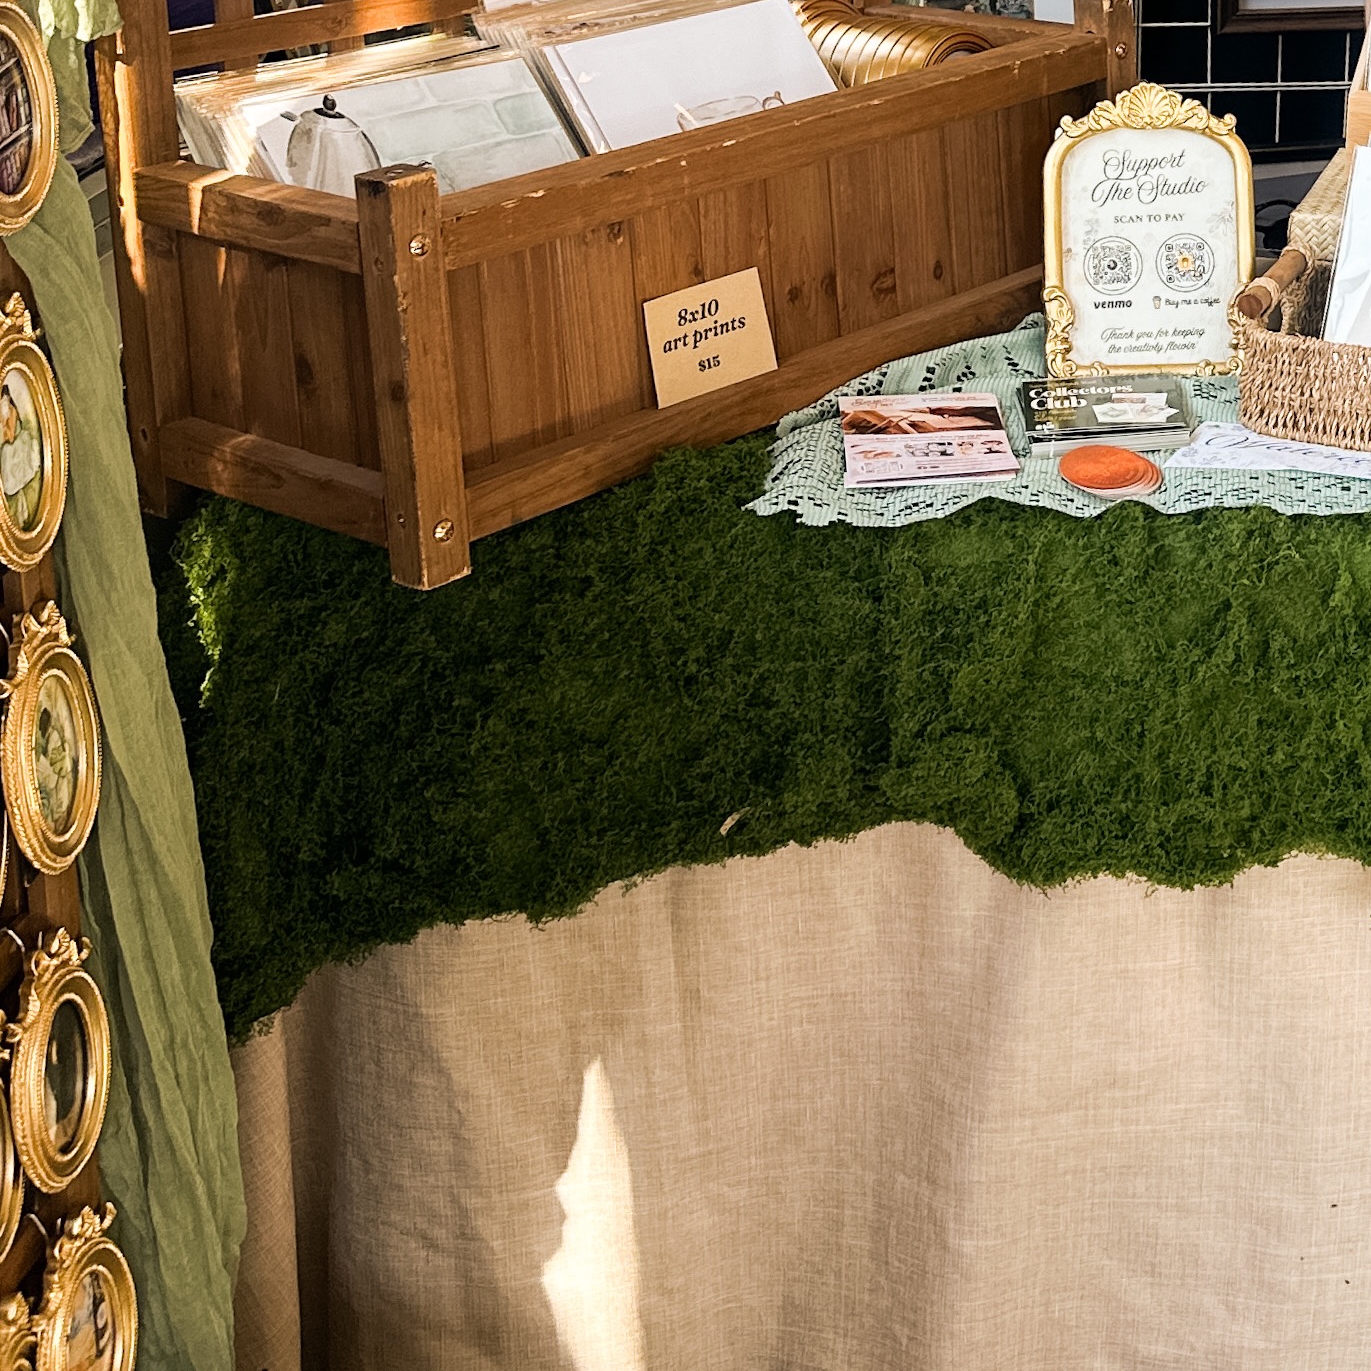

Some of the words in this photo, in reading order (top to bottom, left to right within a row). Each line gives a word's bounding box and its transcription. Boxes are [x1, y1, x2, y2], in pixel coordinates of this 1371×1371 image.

[1103, 149, 1186, 181] Support
[1092, 179, 1134, 207] The
[1137, 174, 1209, 205] Studio
[1114, 215, 1144, 225] SCAN
[1146, 214, 1162, 223] TO
[1164, 213, 1186, 222] PAY
[1093, 299, 1133, 310] venmo
[1164, 297, 1179, 309] Buy
[1180, 297, 1192, 305] me
[1200, 296, 1221, 307] coffee
[678, 299, 719, 327] 8x10
[663, 333, 689, 353] art
[692, 316, 746, 349] prints
[1100, 327, 1134, 343] Thank
[1135, 331, 1154, 341] you
[1154, 328, 1170, 340] for
[1171, 327, 1206, 340] keeping
[1108, 343, 1122, 355] the
[698, 355, 720, 373] $15
[1029, 385, 1133, 398] Collectors
[1030, 396, 1088, 411] Club
